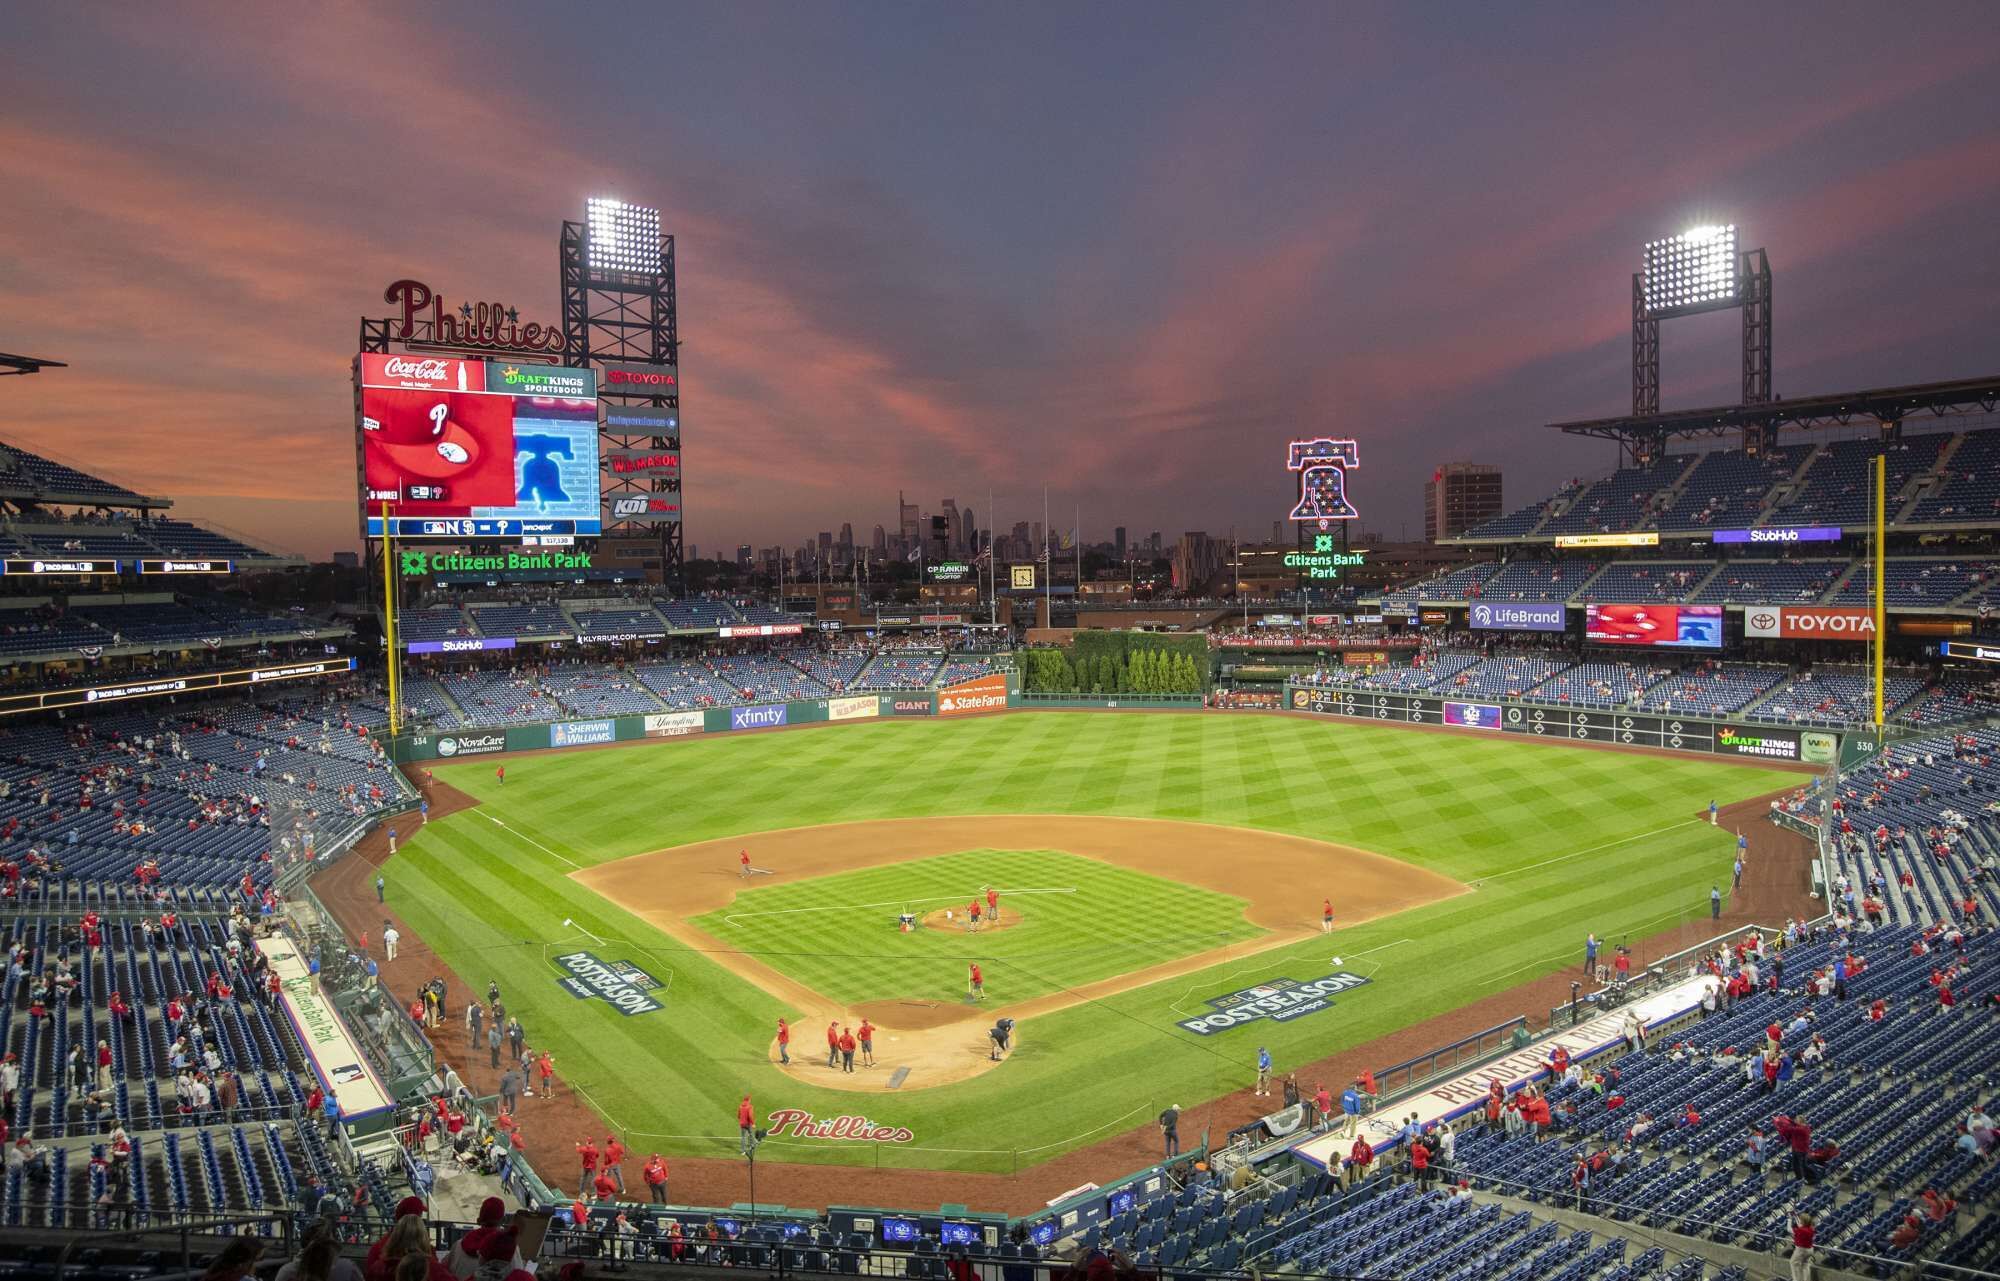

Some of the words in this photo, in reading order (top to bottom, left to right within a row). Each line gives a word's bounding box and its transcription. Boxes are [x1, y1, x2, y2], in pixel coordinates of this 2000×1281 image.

[384, 280, 567, 352] Phillies
[384, 357, 448, 380] Coca-Cola
[505, 374, 584, 387] DRAFTKINGS
[626, 372, 675, 385] TOYOTA
[524, 384, 583, 394] SPORTSBOOK
[1750, 530, 1798, 541] StubHub
[432, 552, 504, 570] Citizens
[508, 553, 552, 569] Bank
[554, 551, 591, 569] Park
[1284, 555, 1332, 566] Citizens
[1333, 554, 1364, 565] Bank
[1310, 567, 1337, 578] Park
[1495, 610, 1559, 624] LifeBrand
[1785, 615, 1876, 632] TOYOTA
[733, 627, 760, 635] TOYOTA
[773, 625, 799, 633] TOYOTA
[583, 633, 637, 643] KLYRRUM.COM
[442, 640, 483, 651] StubHub
[894, 701, 930, 710] GIANT
[956, 696, 981, 709] State
[982, 694, 1006, 707] Farm
[735, 708, 783, 728] xfinity
[568, 723, 609, 734] SHERWIN
[662, 728, 688, 736] LAGER
[458, 735, 505, 748] NovaCare
[565, 733, 611, 744] WILLIAMS
[1721, 735, 1796, 750] DRAFTKINGS
[1738, 744, 1796, 757] SPORTSBOOK
[1856, 741, 1873, 751] 330
[559, 952, 657, 1015] POSTSEASON
[1184, 973, 1365, 1033] POSTSEASON
[767, 1108, 914, 1143] Phillies
